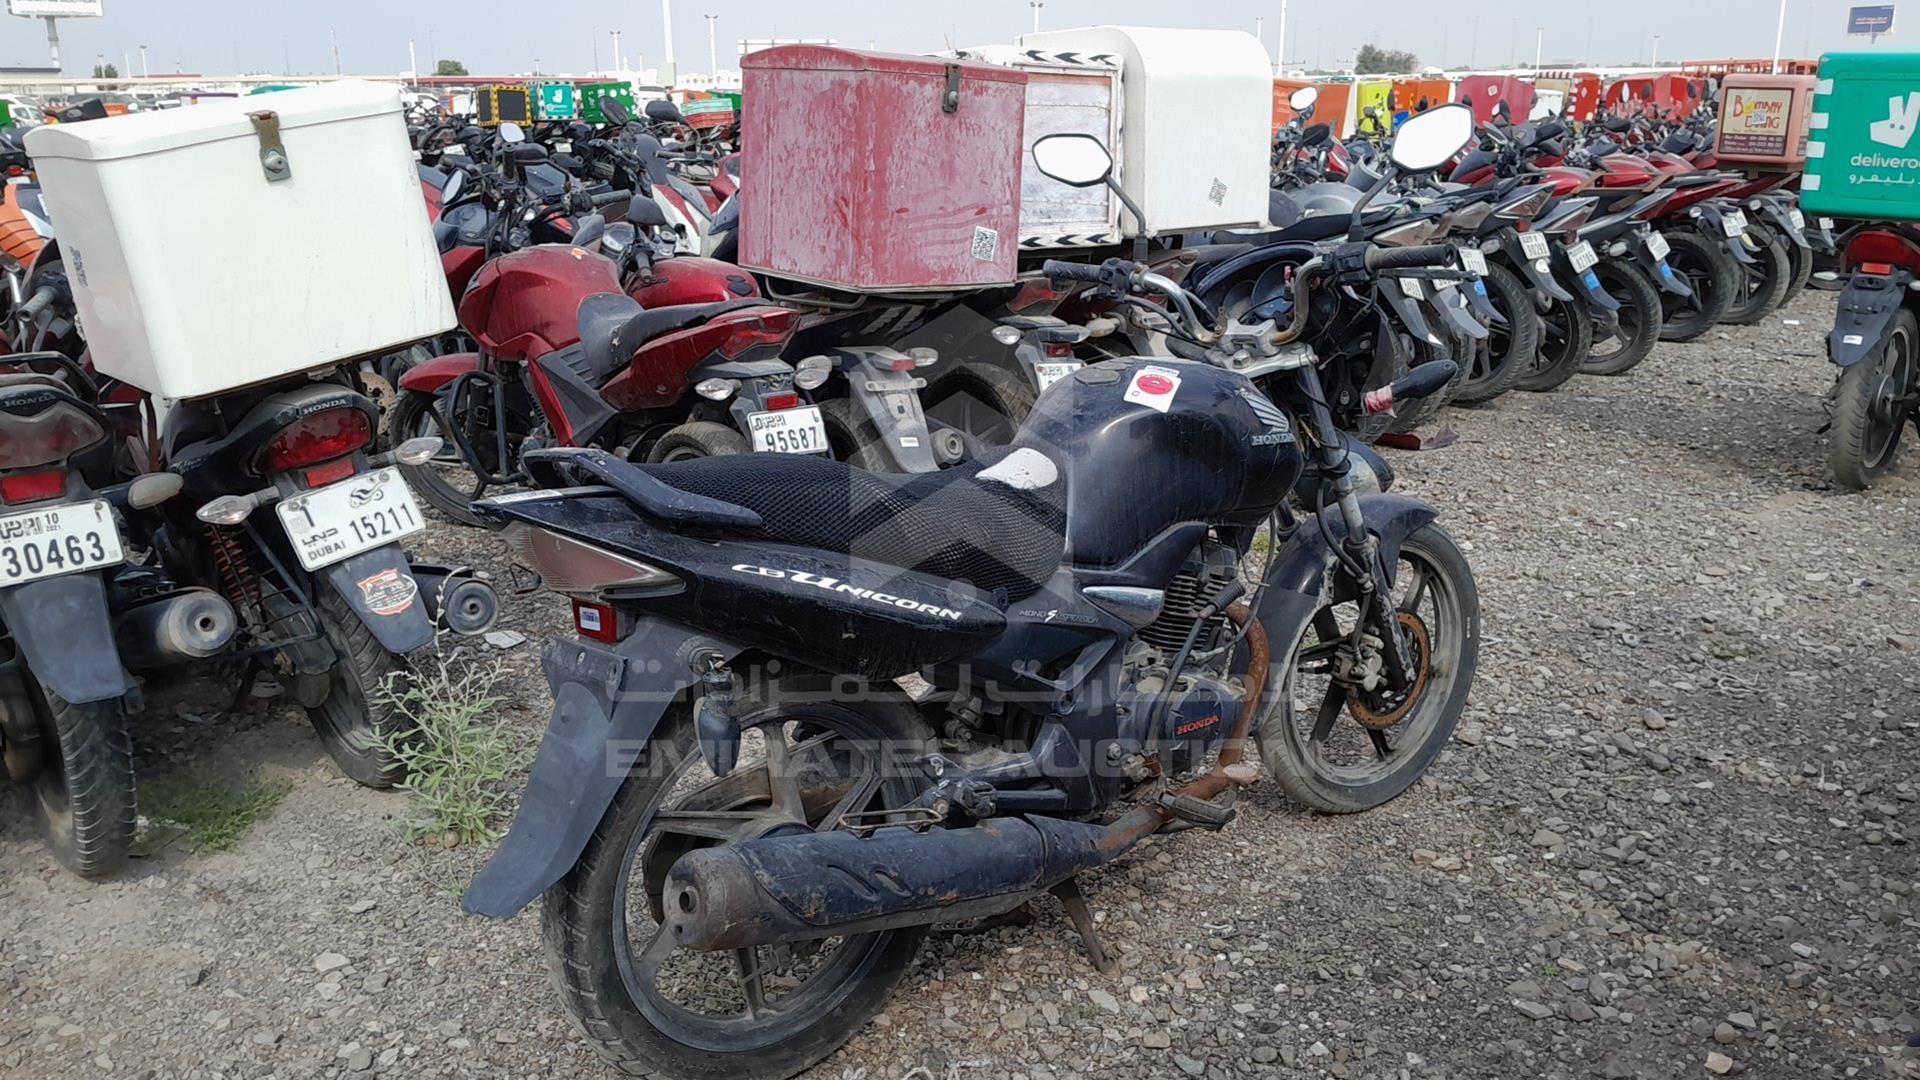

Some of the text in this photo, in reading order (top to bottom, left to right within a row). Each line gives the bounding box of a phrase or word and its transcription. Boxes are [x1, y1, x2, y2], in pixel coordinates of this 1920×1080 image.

[1850, 152, 1920, 169] delivero
[1849, 172, 1920, 187] يليفرو
[303, 399, 347, 415] HONDA
[765, 426, 817, 452] 95687
[1251, 432, 1297, 446] HONDA
[44, 512, 60, 525] 10
[349, 502, 416, 543] 15211
[1, 531, 105, 578] 30463
[307, 540, 347, 561] DUBAI
[1177, 714, 1220, 735] HONDA
